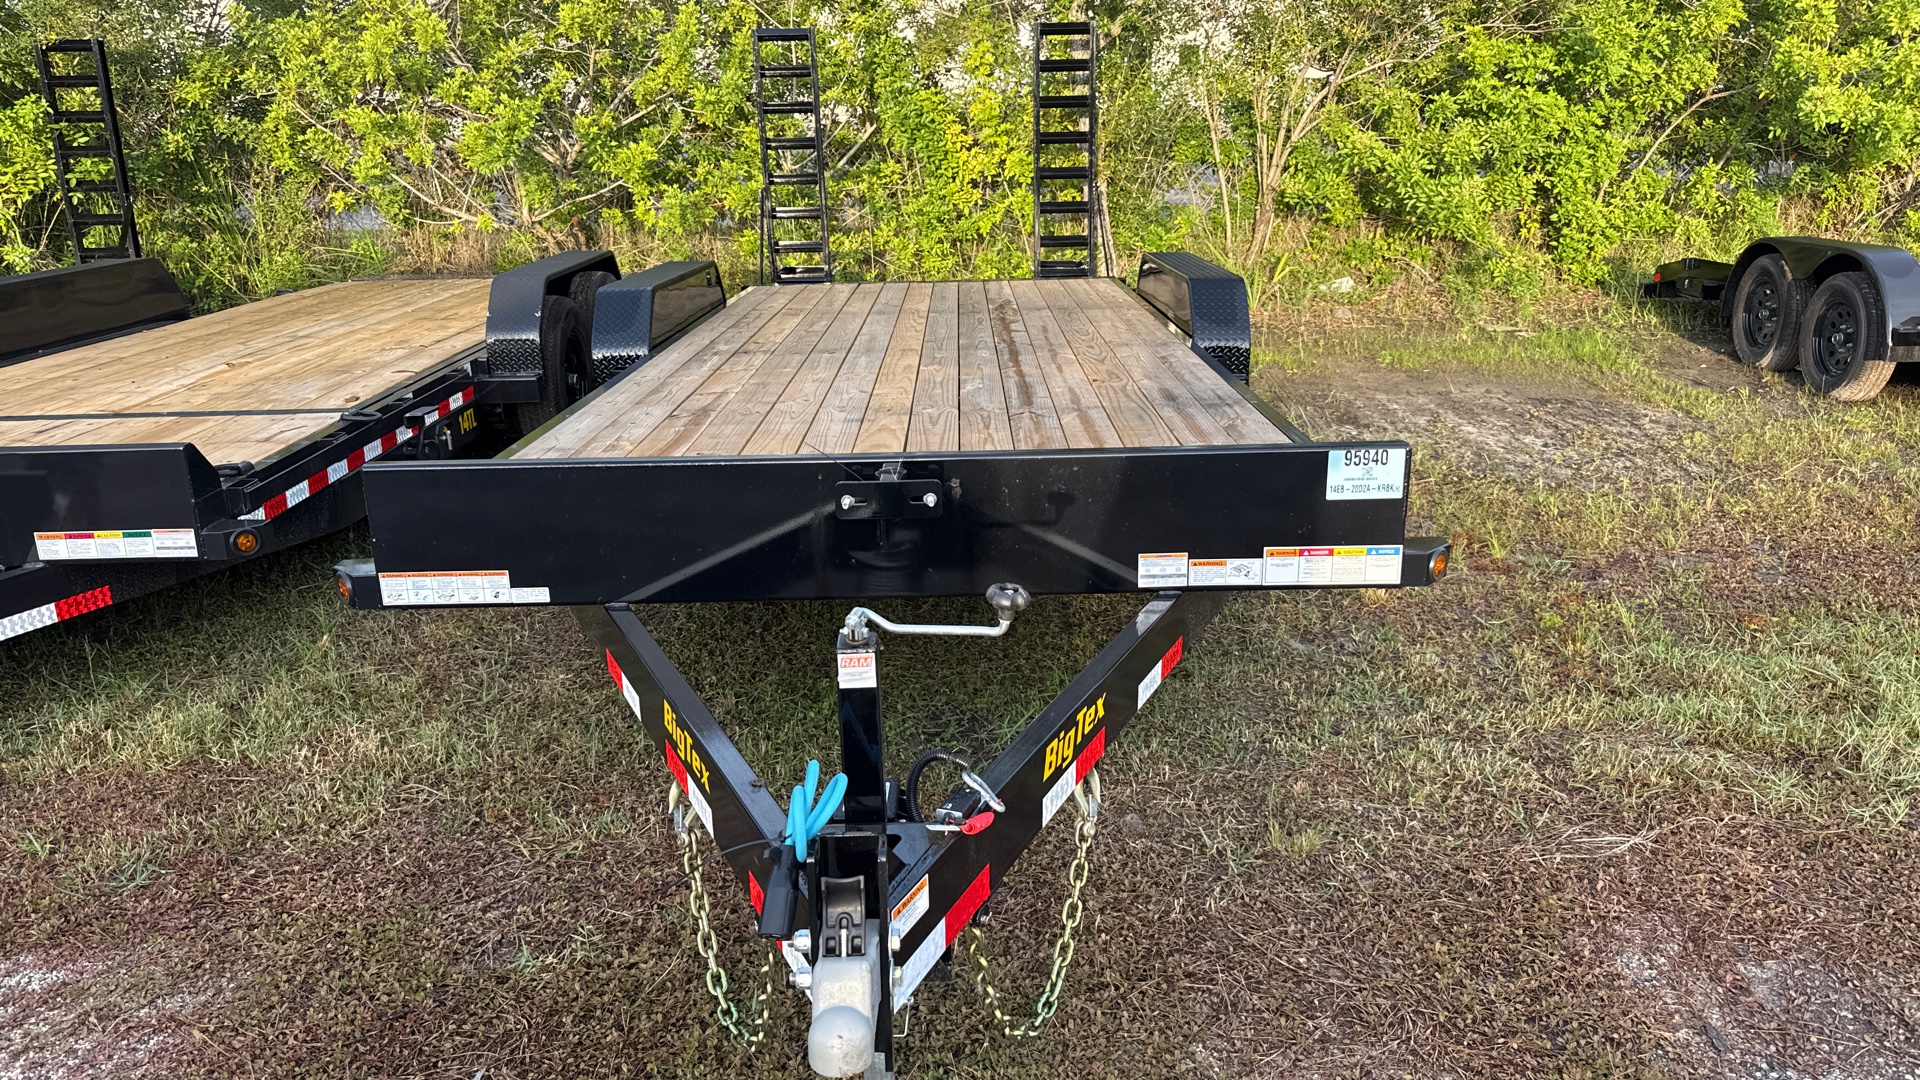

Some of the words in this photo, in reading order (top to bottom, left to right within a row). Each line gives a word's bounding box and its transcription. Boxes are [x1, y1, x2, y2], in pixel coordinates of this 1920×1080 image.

[458, 407, 478, 435] 14TL
[1344, 449, 1389, 467] 95940
[841, 658, 872, 668] RAM
[902, 882, 925, 909] WARNING
